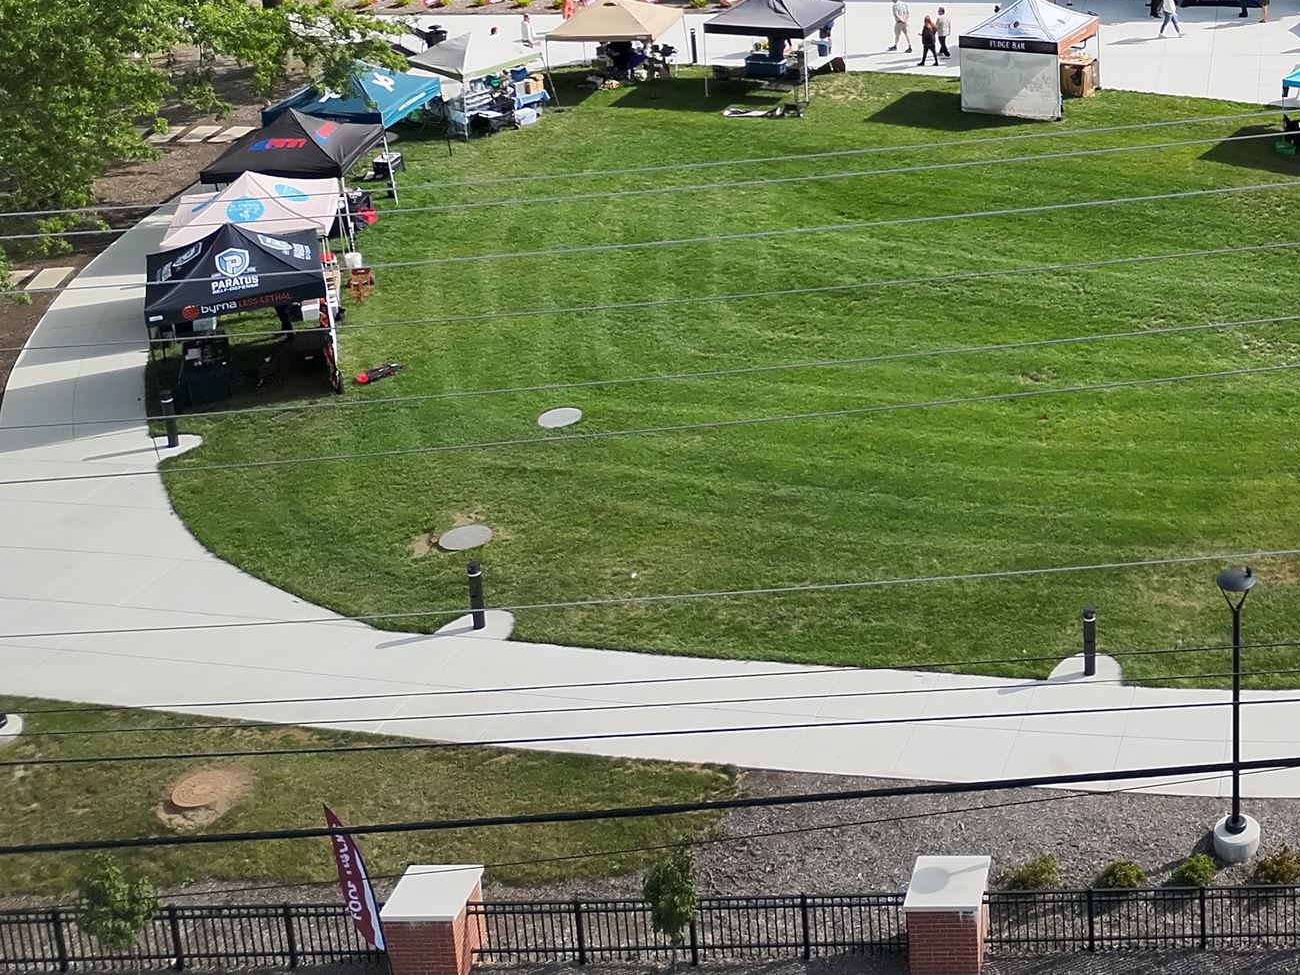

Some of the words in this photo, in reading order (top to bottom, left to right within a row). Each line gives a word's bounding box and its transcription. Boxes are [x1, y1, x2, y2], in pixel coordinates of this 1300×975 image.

[989, 39, 1010, 49] FUDGE
[211, 275, 259, 291] PARATUS
[201, 301, 238, 314] byrna
